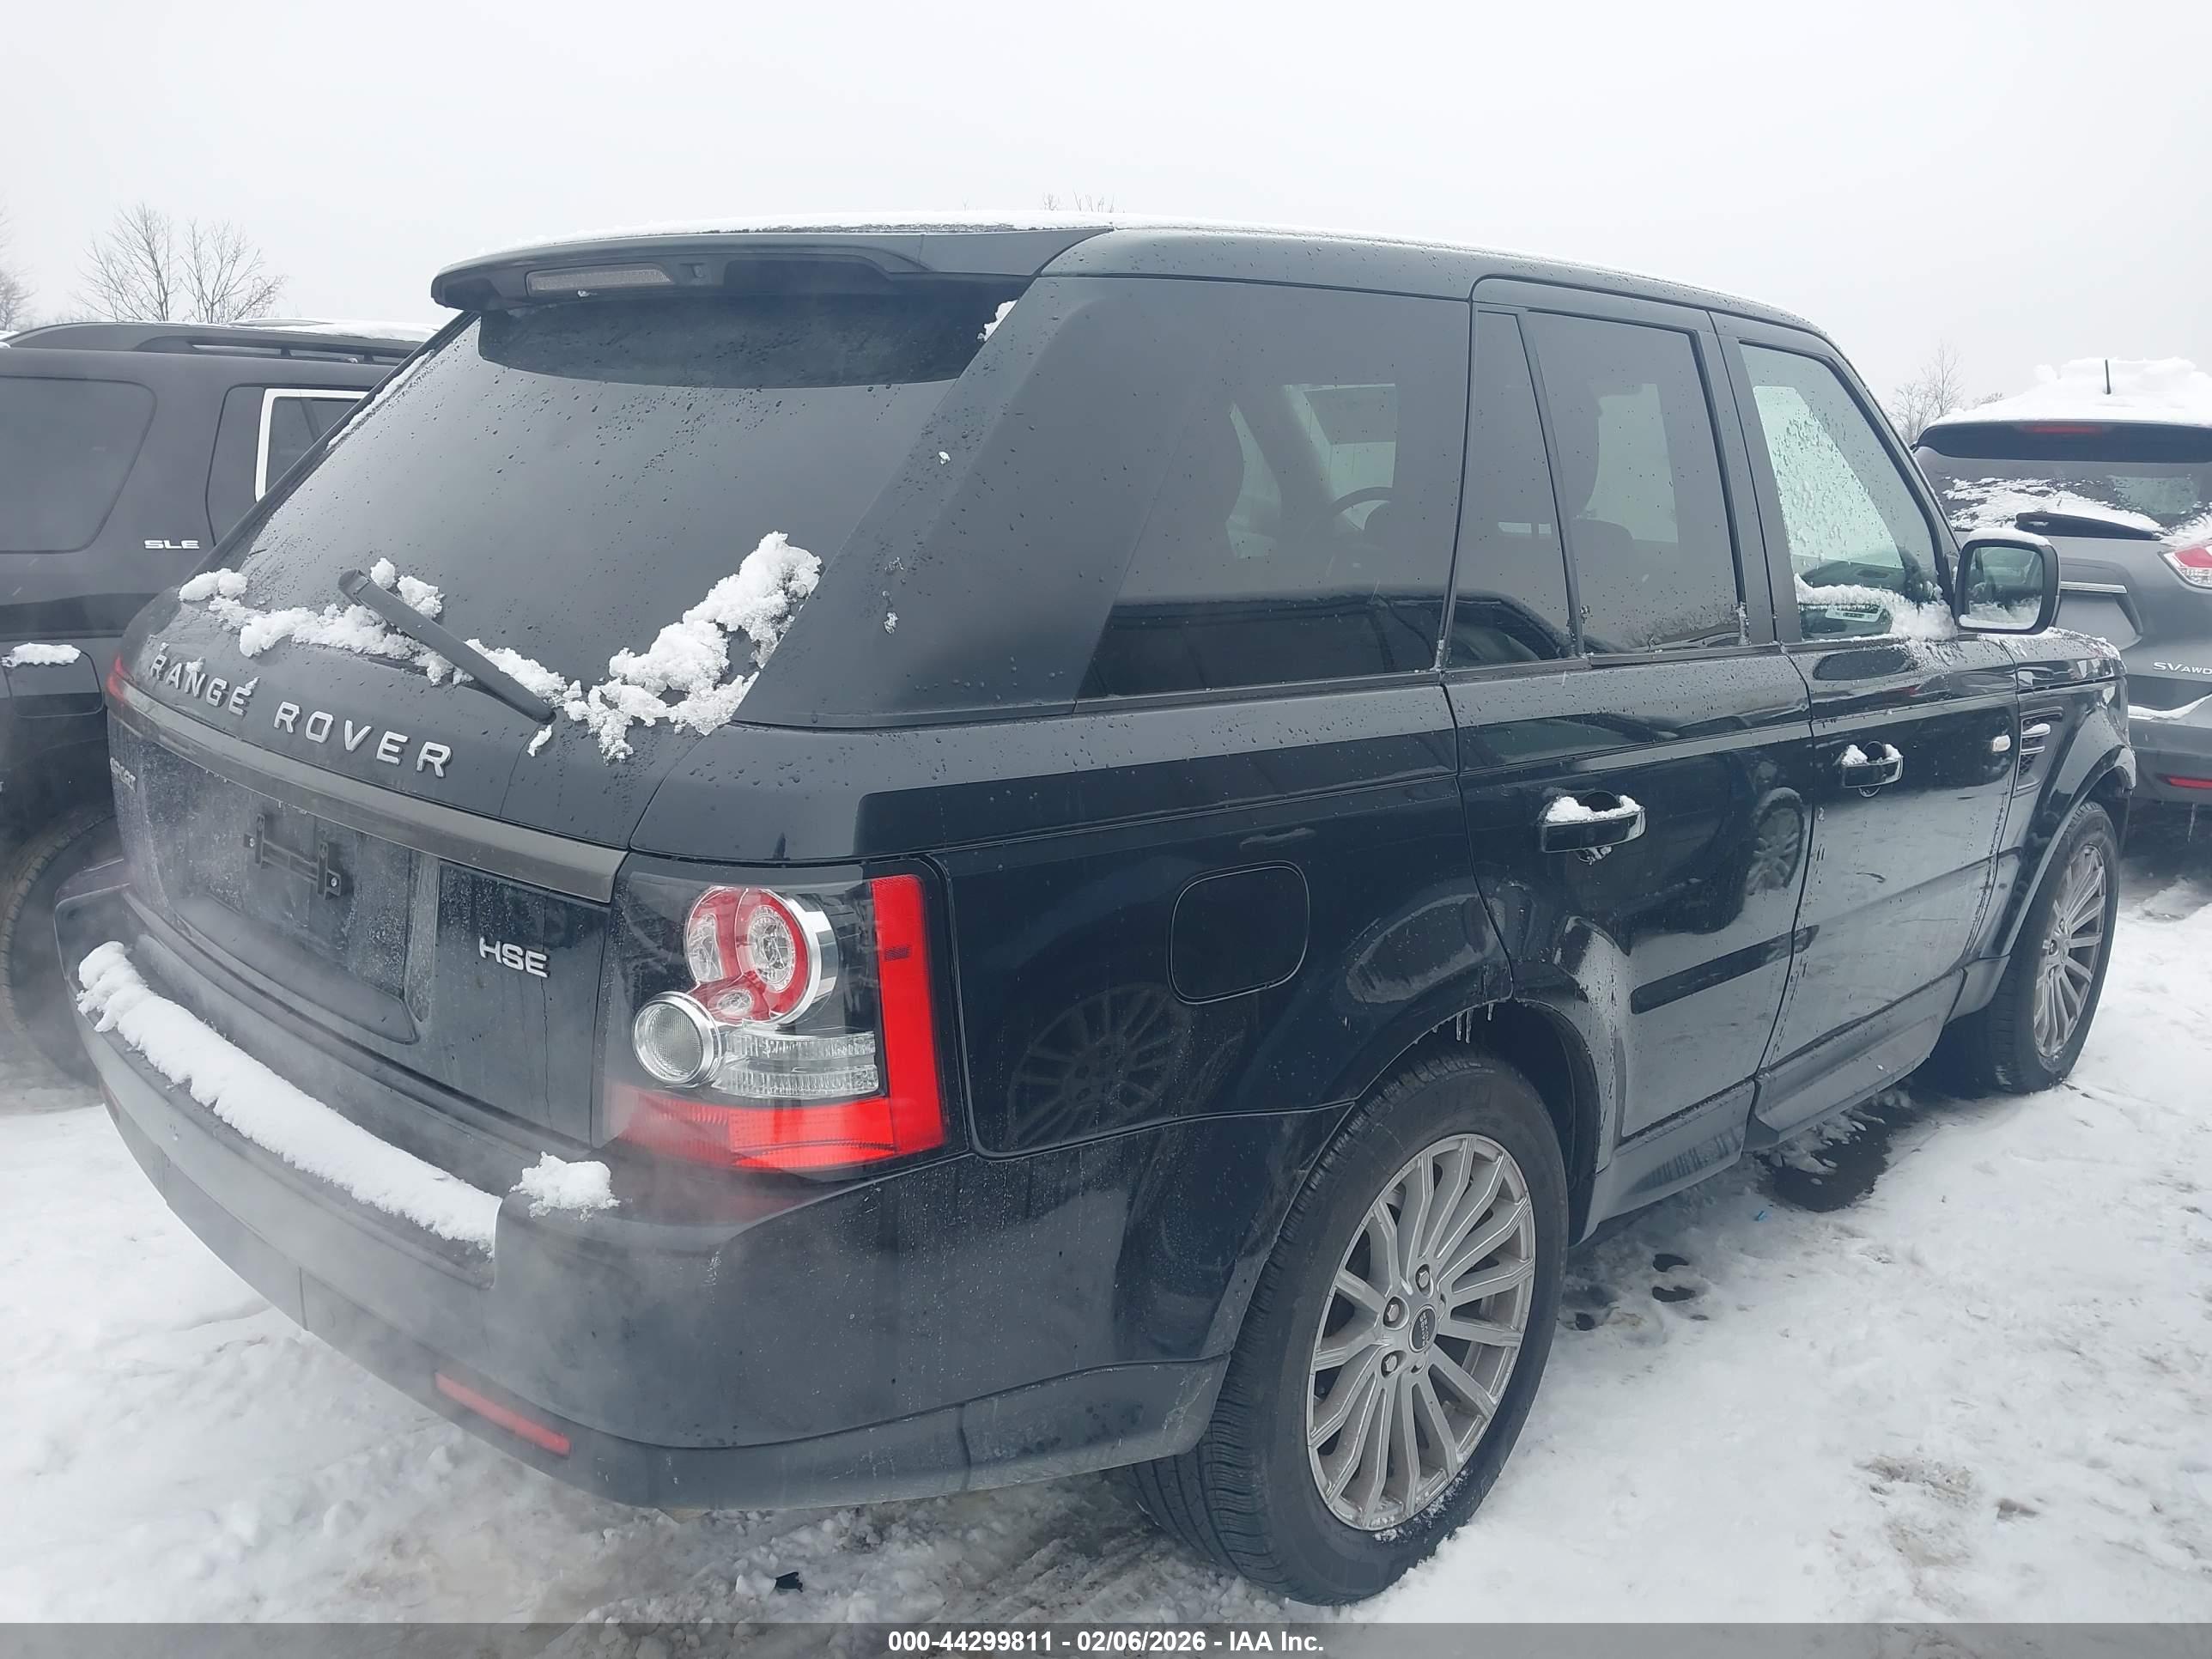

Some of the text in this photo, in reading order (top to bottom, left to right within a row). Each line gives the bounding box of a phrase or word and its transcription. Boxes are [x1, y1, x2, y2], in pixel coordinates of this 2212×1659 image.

[144, 539, 200, 550] SLE
[149, 653, 453, 778] RANGE ROVER
[478, 936, 549, 978] HSE
